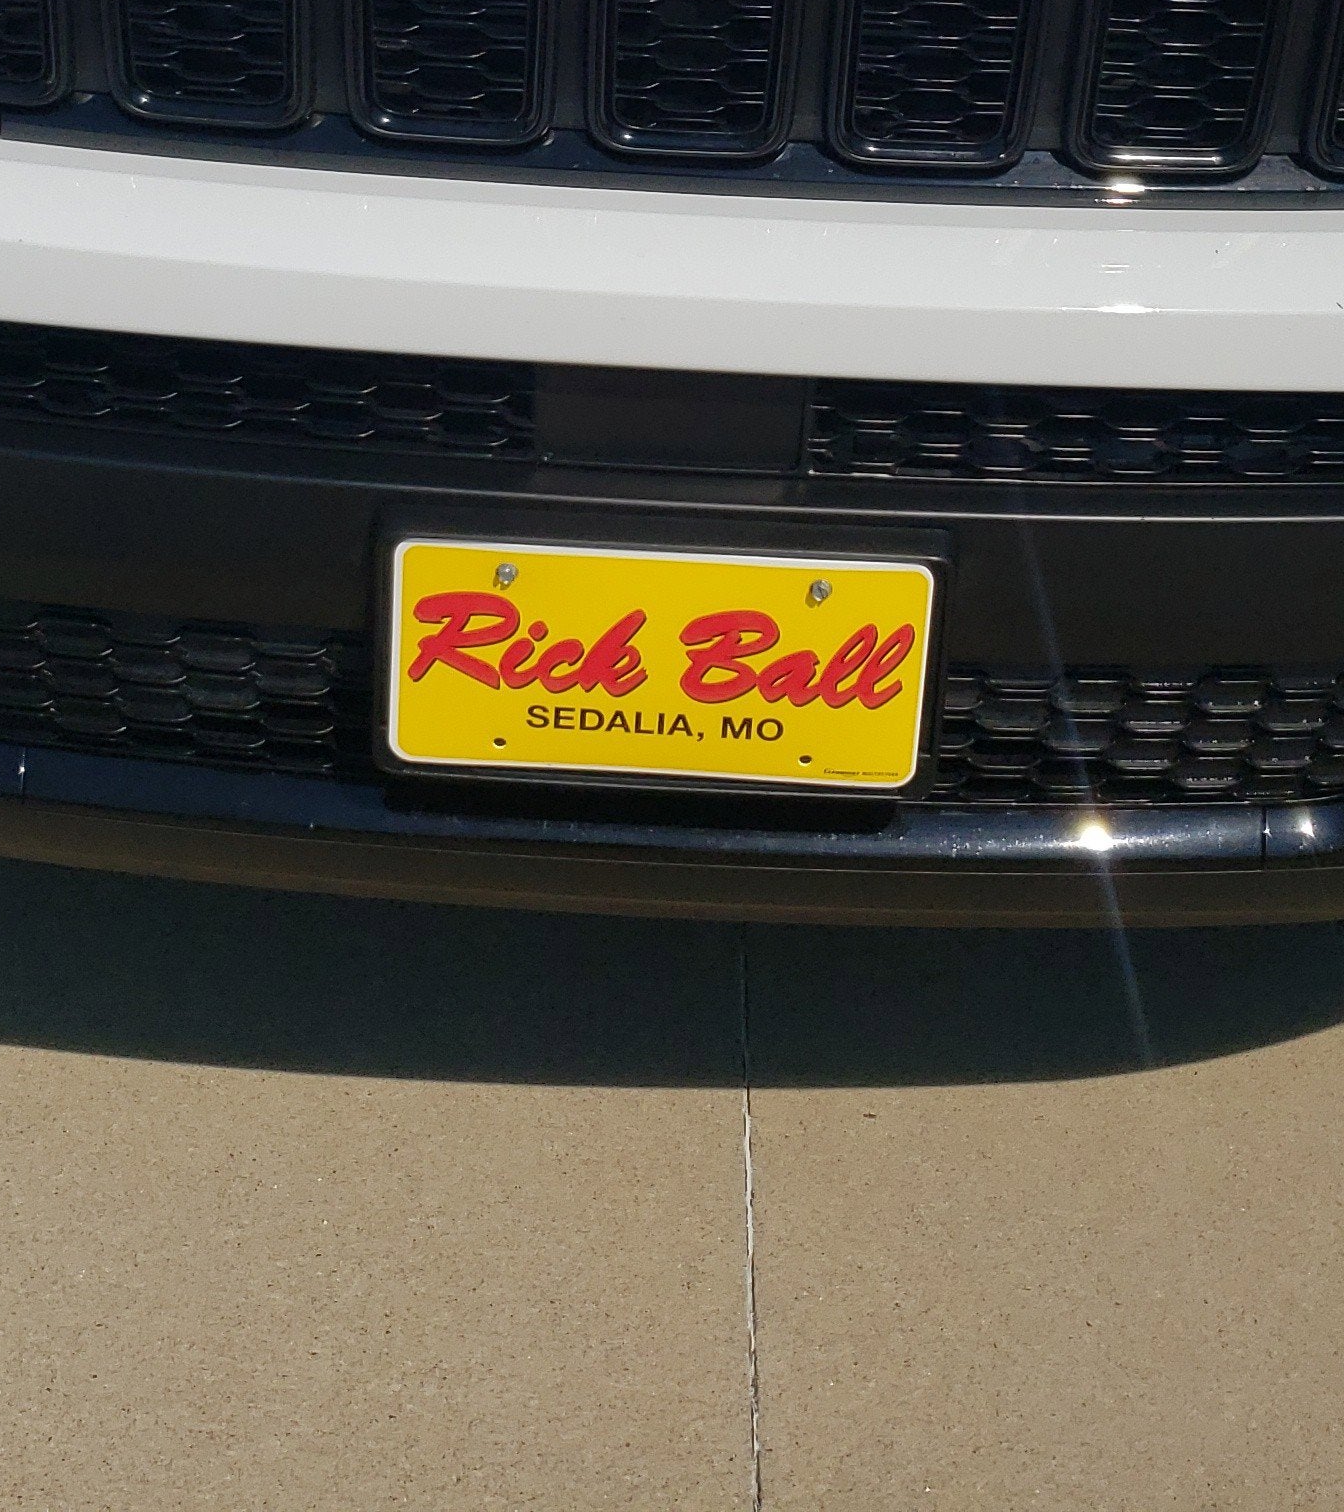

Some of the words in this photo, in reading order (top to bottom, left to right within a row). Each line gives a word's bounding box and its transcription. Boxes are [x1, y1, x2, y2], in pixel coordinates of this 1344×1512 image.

[407, 591, 649, 697] Rick
[678, 609, 916, 709] Ball
[525, 704, 705, 742] SEDALIA,
[720, 717, 785, 742] MO
